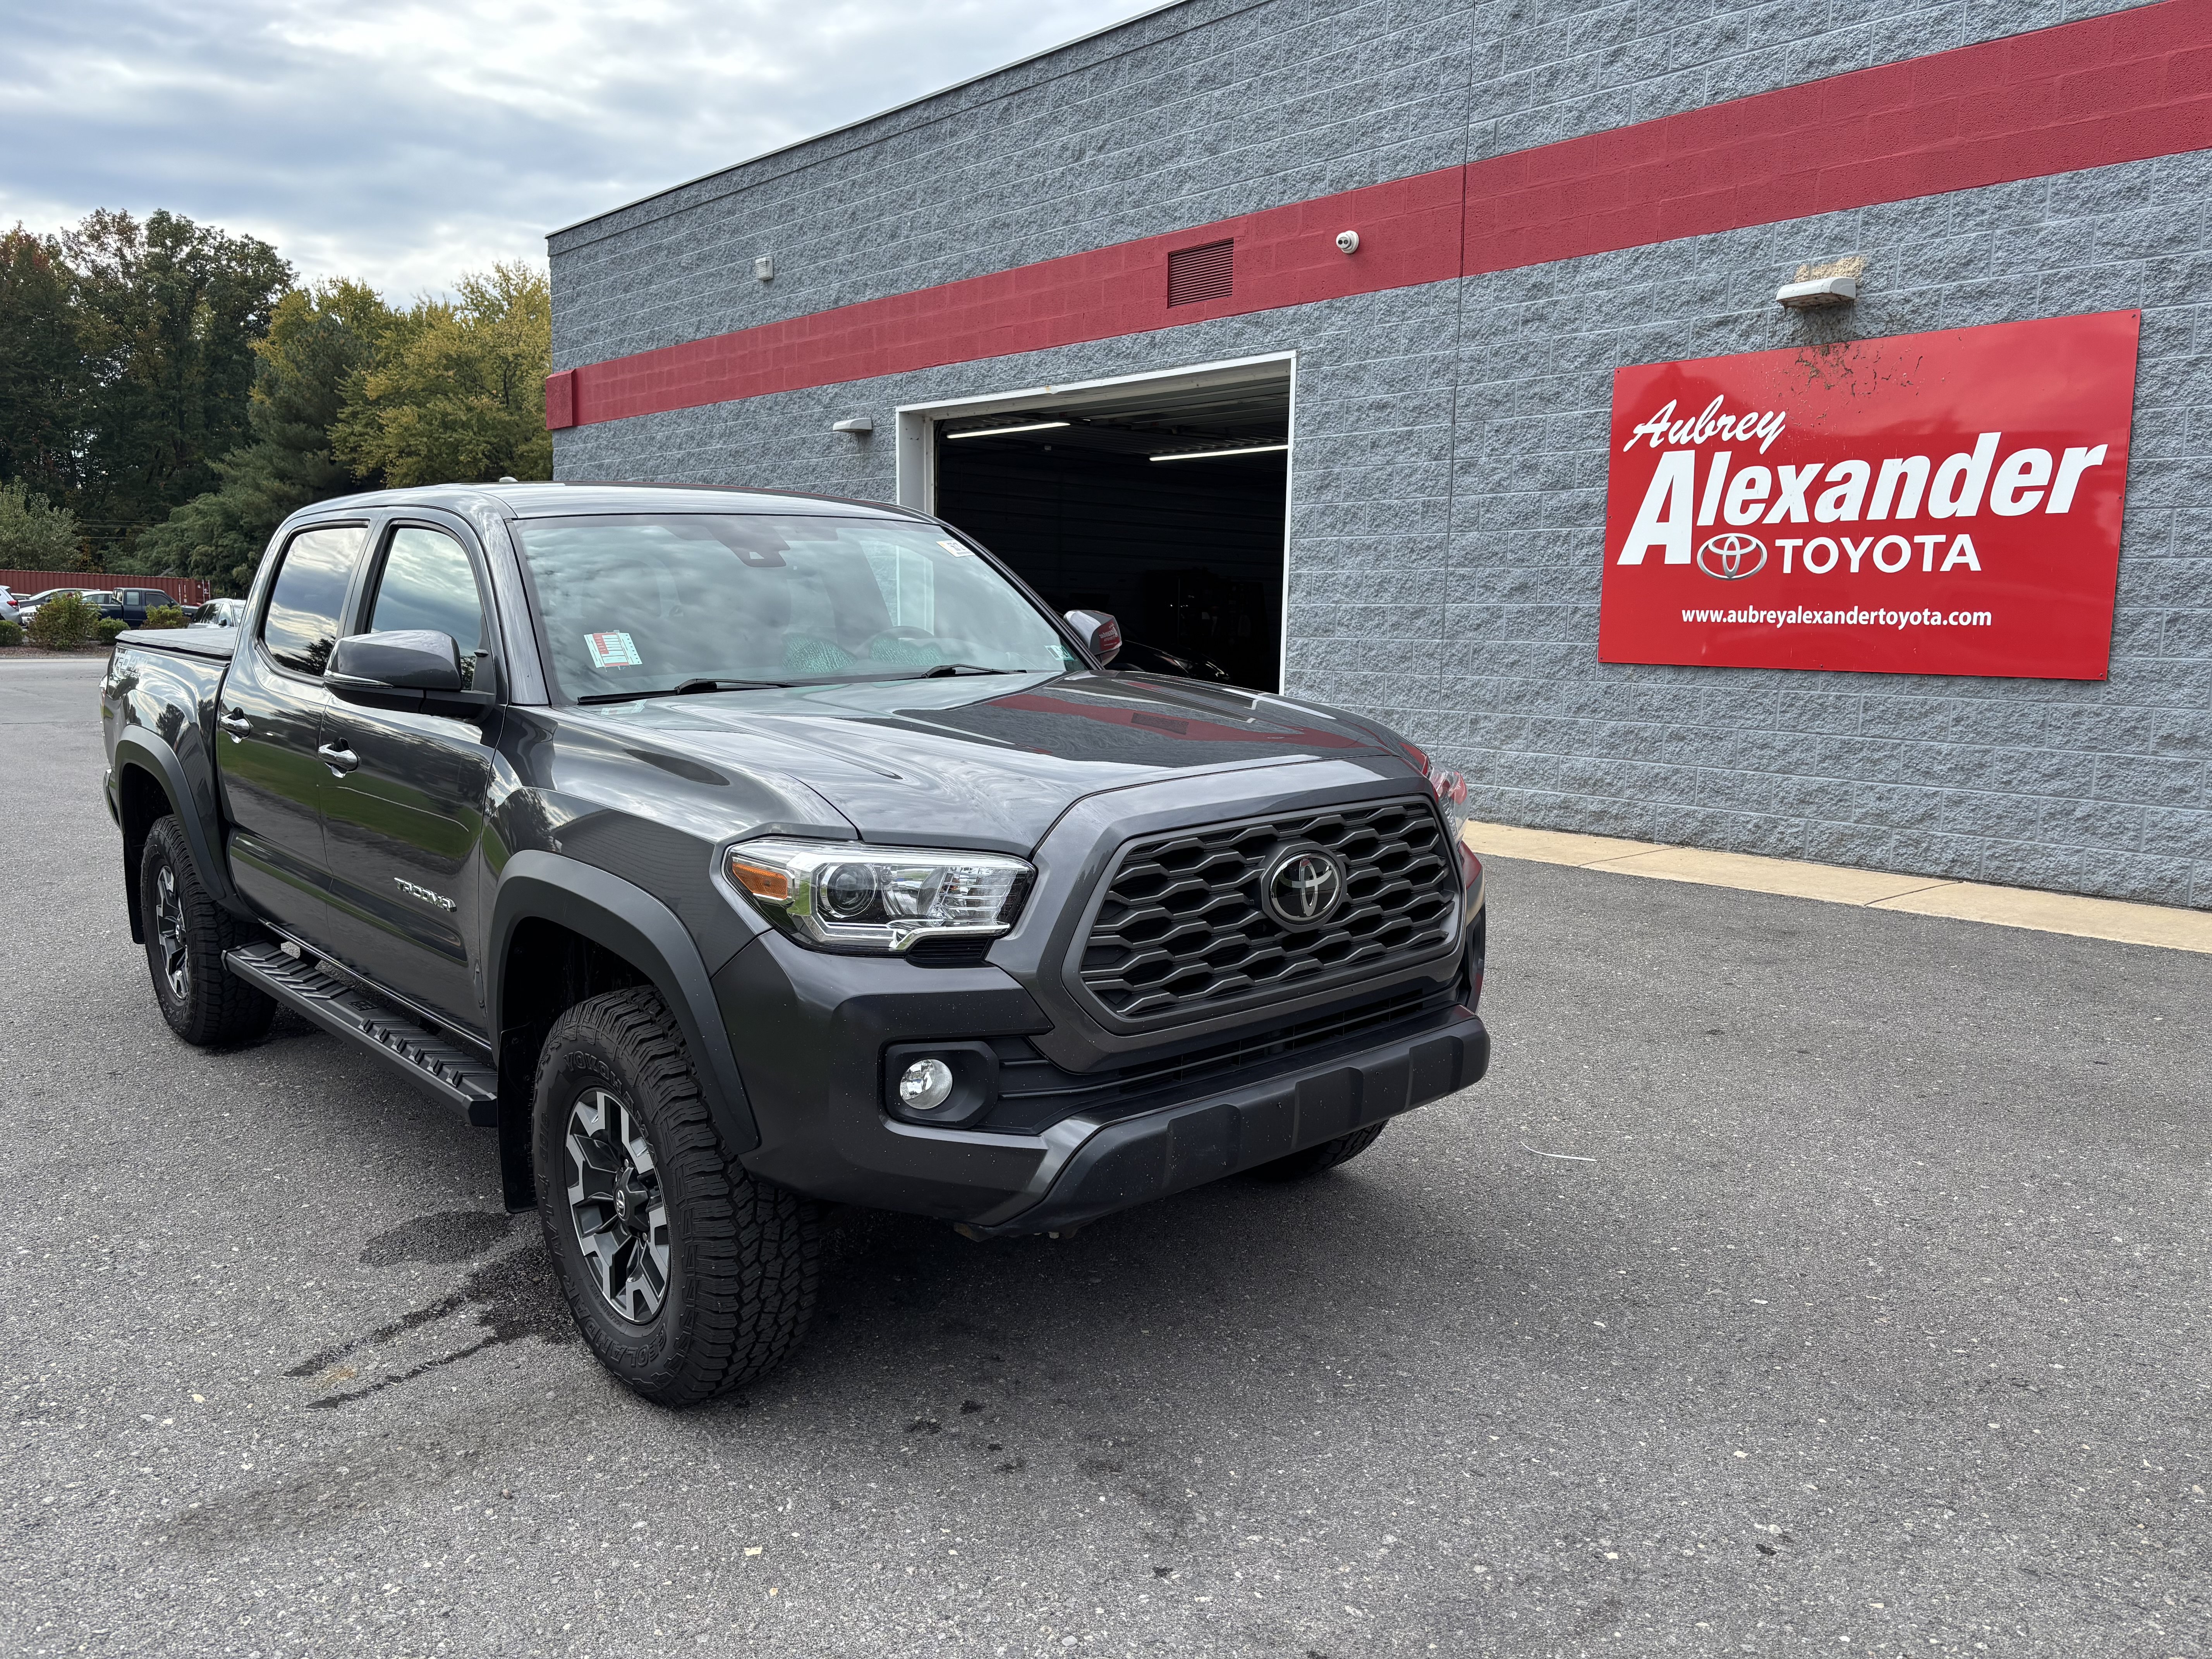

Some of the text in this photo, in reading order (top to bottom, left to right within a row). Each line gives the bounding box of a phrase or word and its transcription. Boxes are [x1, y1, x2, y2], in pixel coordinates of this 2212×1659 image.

[1623, 394, 1786, 454] Aubrey
[1617, 431, 2108, 565] Alexander
[1775, 534, 1982, 574] TOYOTA
[1682, 605, 1992, 630] www.aubreyalexandertoyota.com
[394, 877, 457, 912] TACOMA
[563, 1275, 667, 1368] GEOLANDAR
